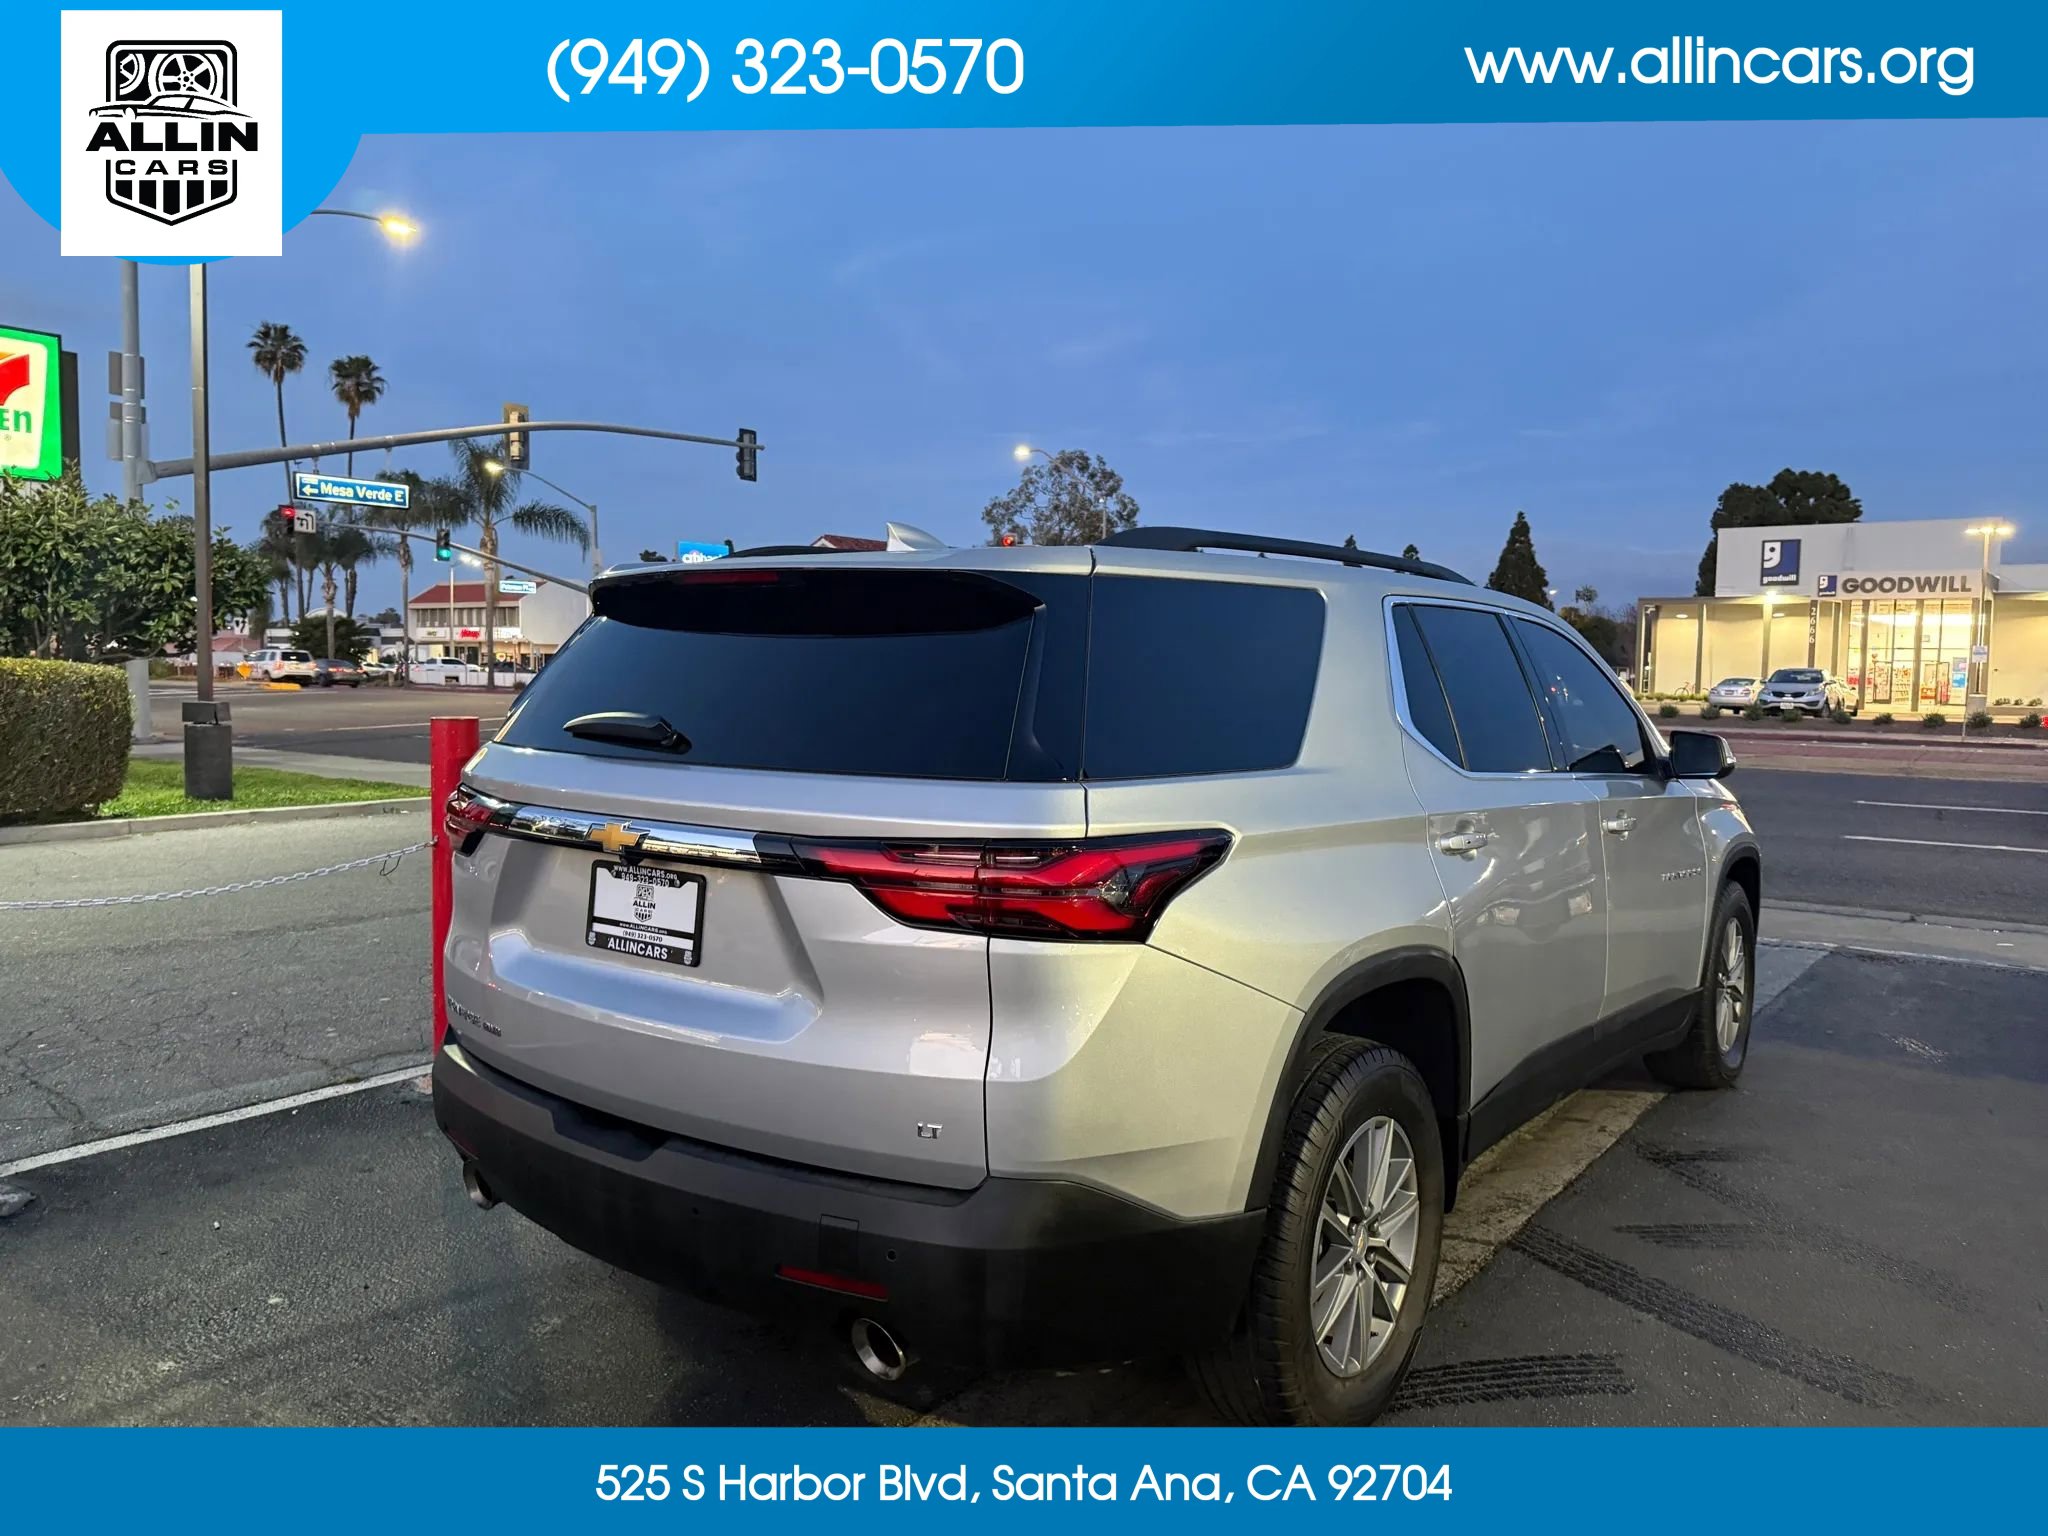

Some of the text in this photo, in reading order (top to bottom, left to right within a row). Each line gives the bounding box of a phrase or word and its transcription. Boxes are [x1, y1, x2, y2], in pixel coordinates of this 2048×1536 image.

[320, 482, 404, 503] Mesa Verde E
[1841, 575, 1972, 594] GOODWILL
[632, 900, 656, 910] ALLIN
[622, 930, 663, 943] (949) 323-0570
[608, 937, 668, 960] ALLINCARS
[917, 1122, 943, 1139] LT
